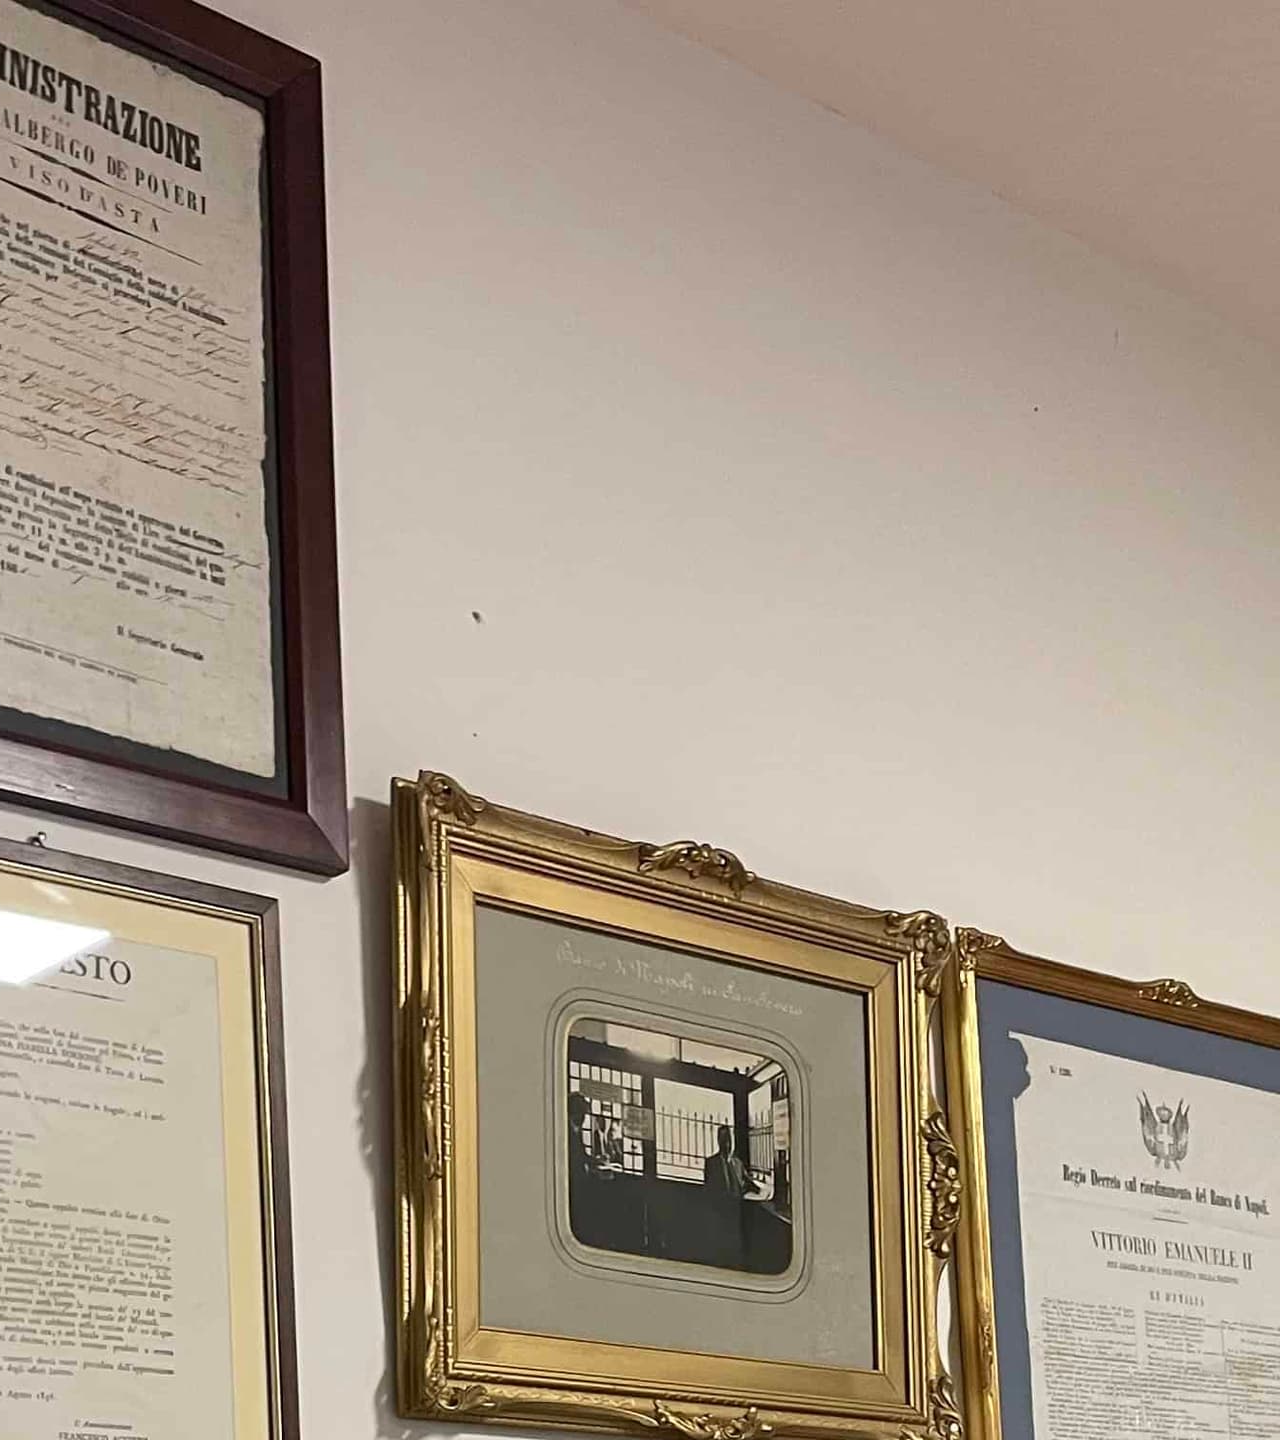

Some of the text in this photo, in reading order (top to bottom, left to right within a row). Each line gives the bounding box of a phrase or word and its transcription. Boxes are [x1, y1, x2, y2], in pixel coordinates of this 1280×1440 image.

[1, 108, 95, 165] ALBERGO
[136, 167, 207, 215] POVERI
[1091, 1231, 1252, 1270] VITTORIO EMANUELE II
